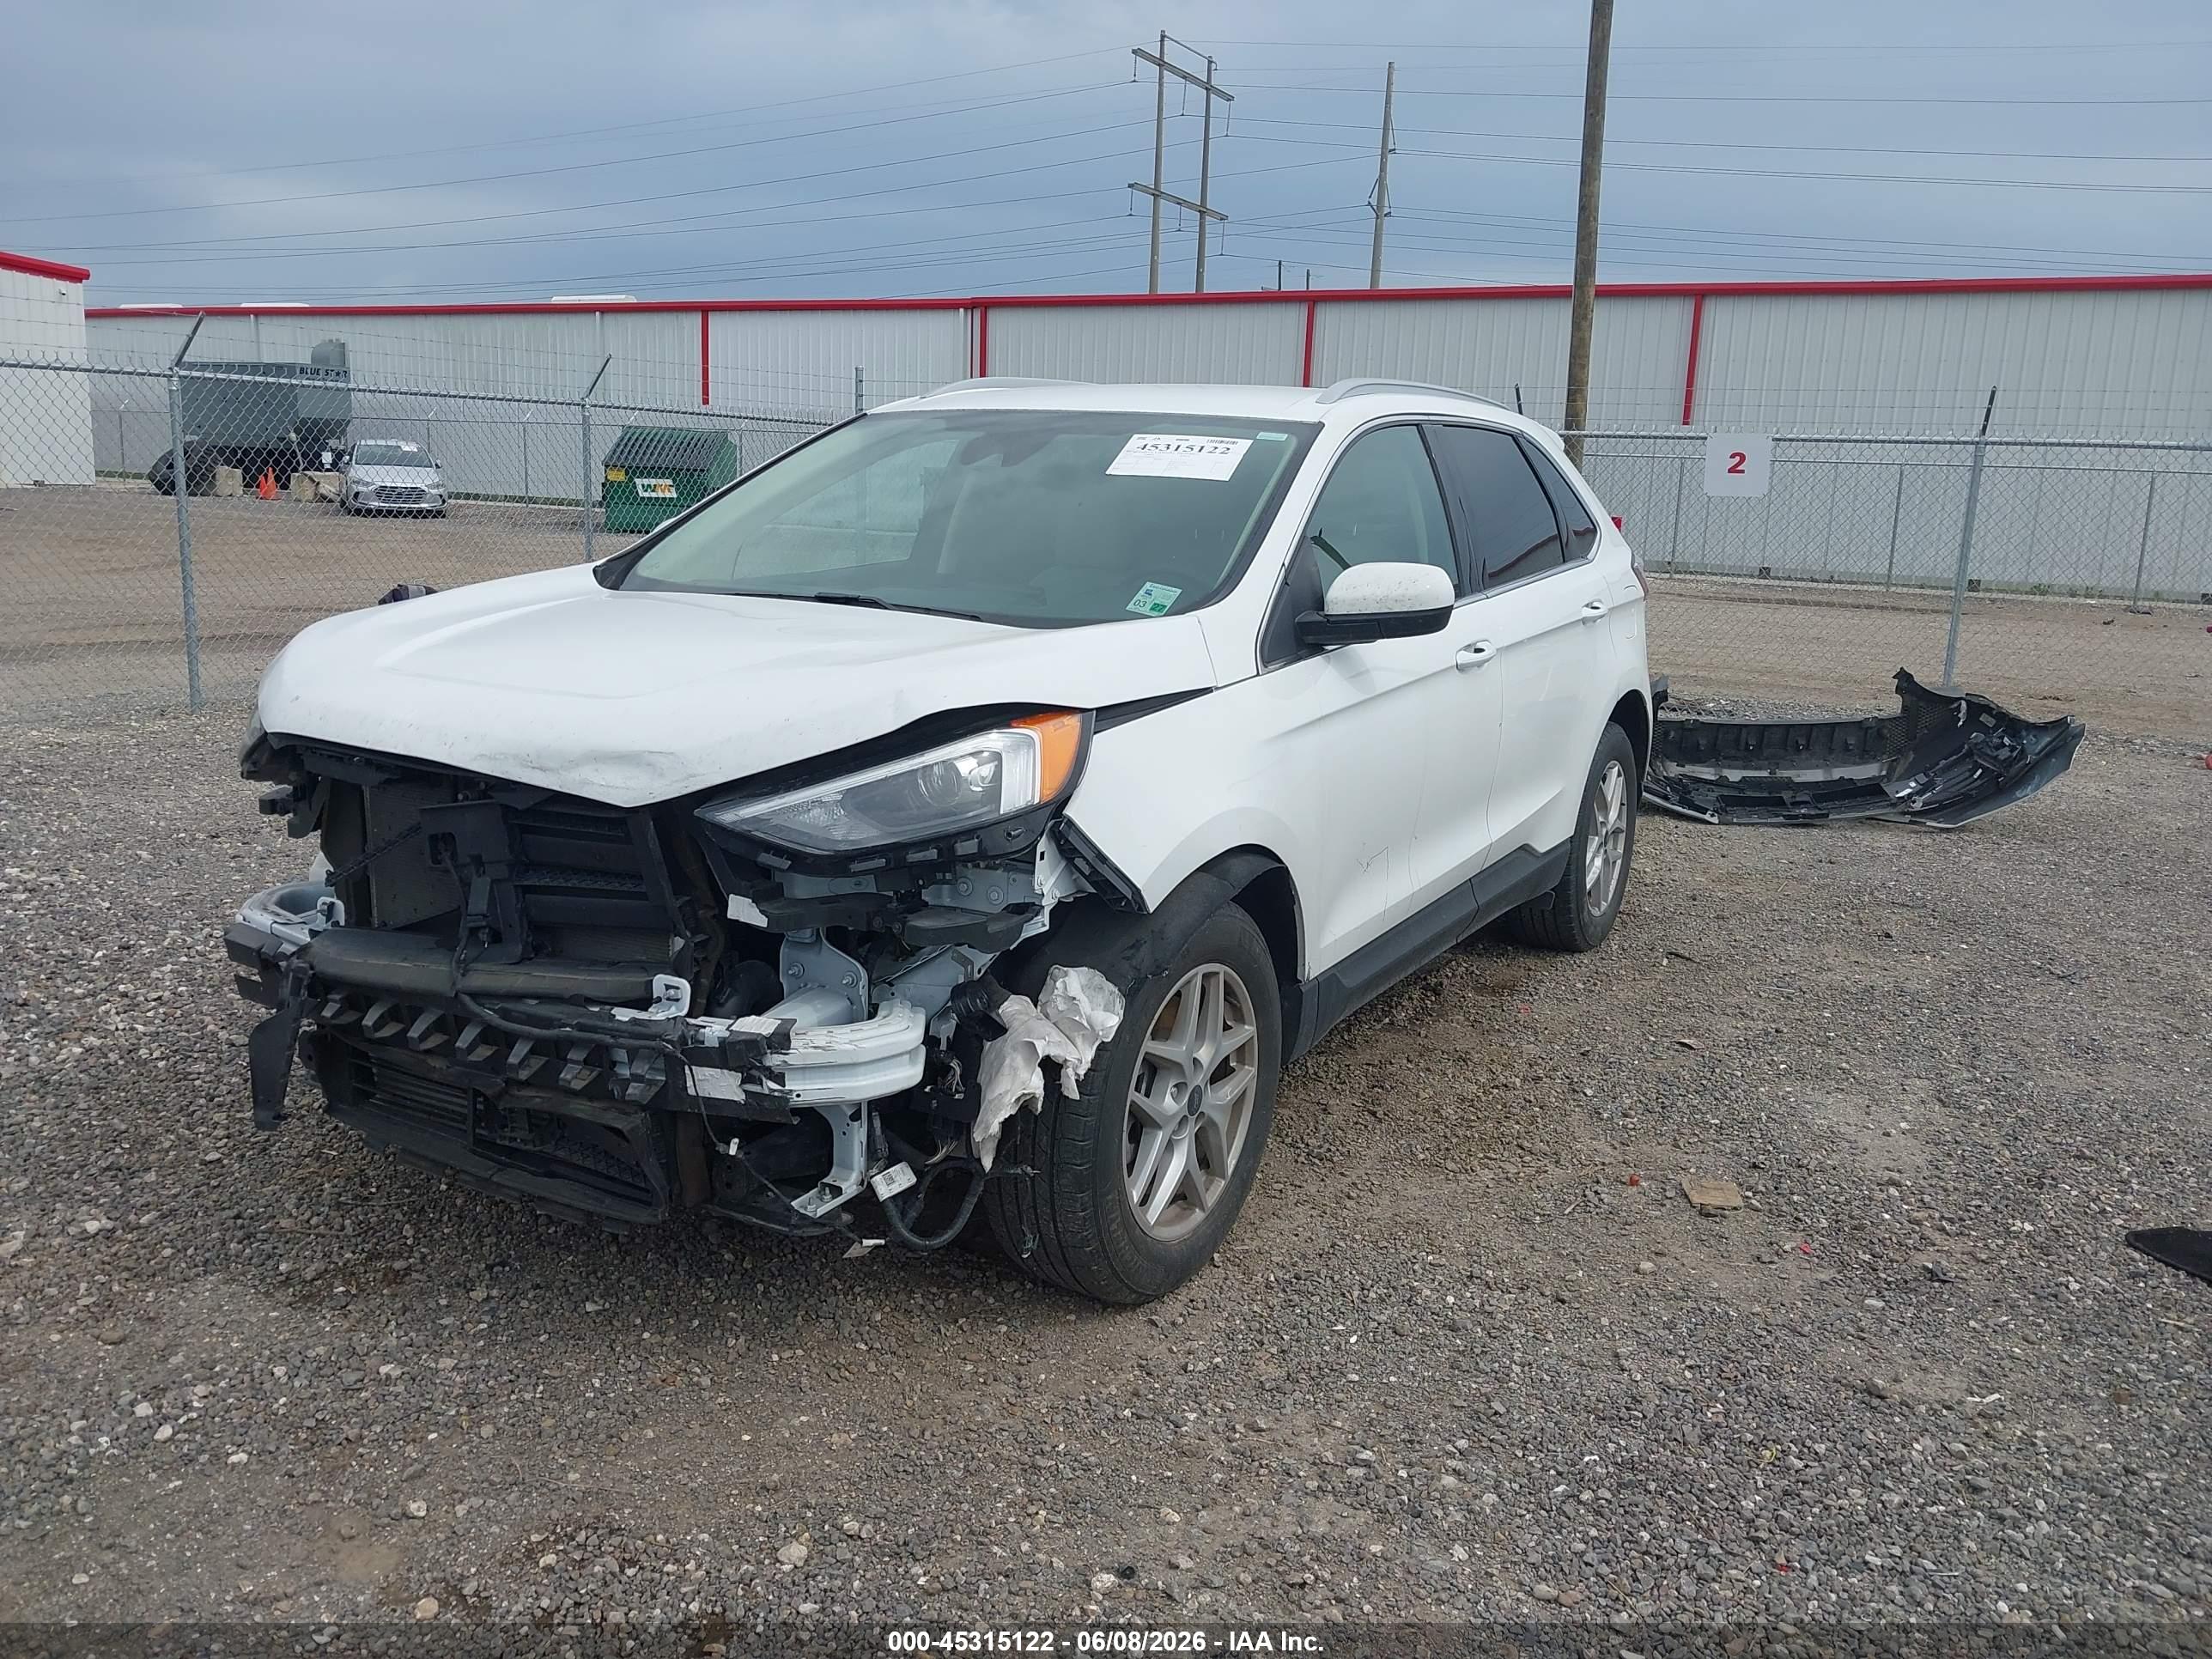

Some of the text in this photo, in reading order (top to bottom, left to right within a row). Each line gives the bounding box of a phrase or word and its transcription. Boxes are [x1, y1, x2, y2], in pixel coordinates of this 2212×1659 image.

[299, 367, 321, 376] BLUE
[1136, 442, 1231, 455] 45315122
[1728, 452, 1747, 474] 2
[1133, 599, 1147, 608] 03
